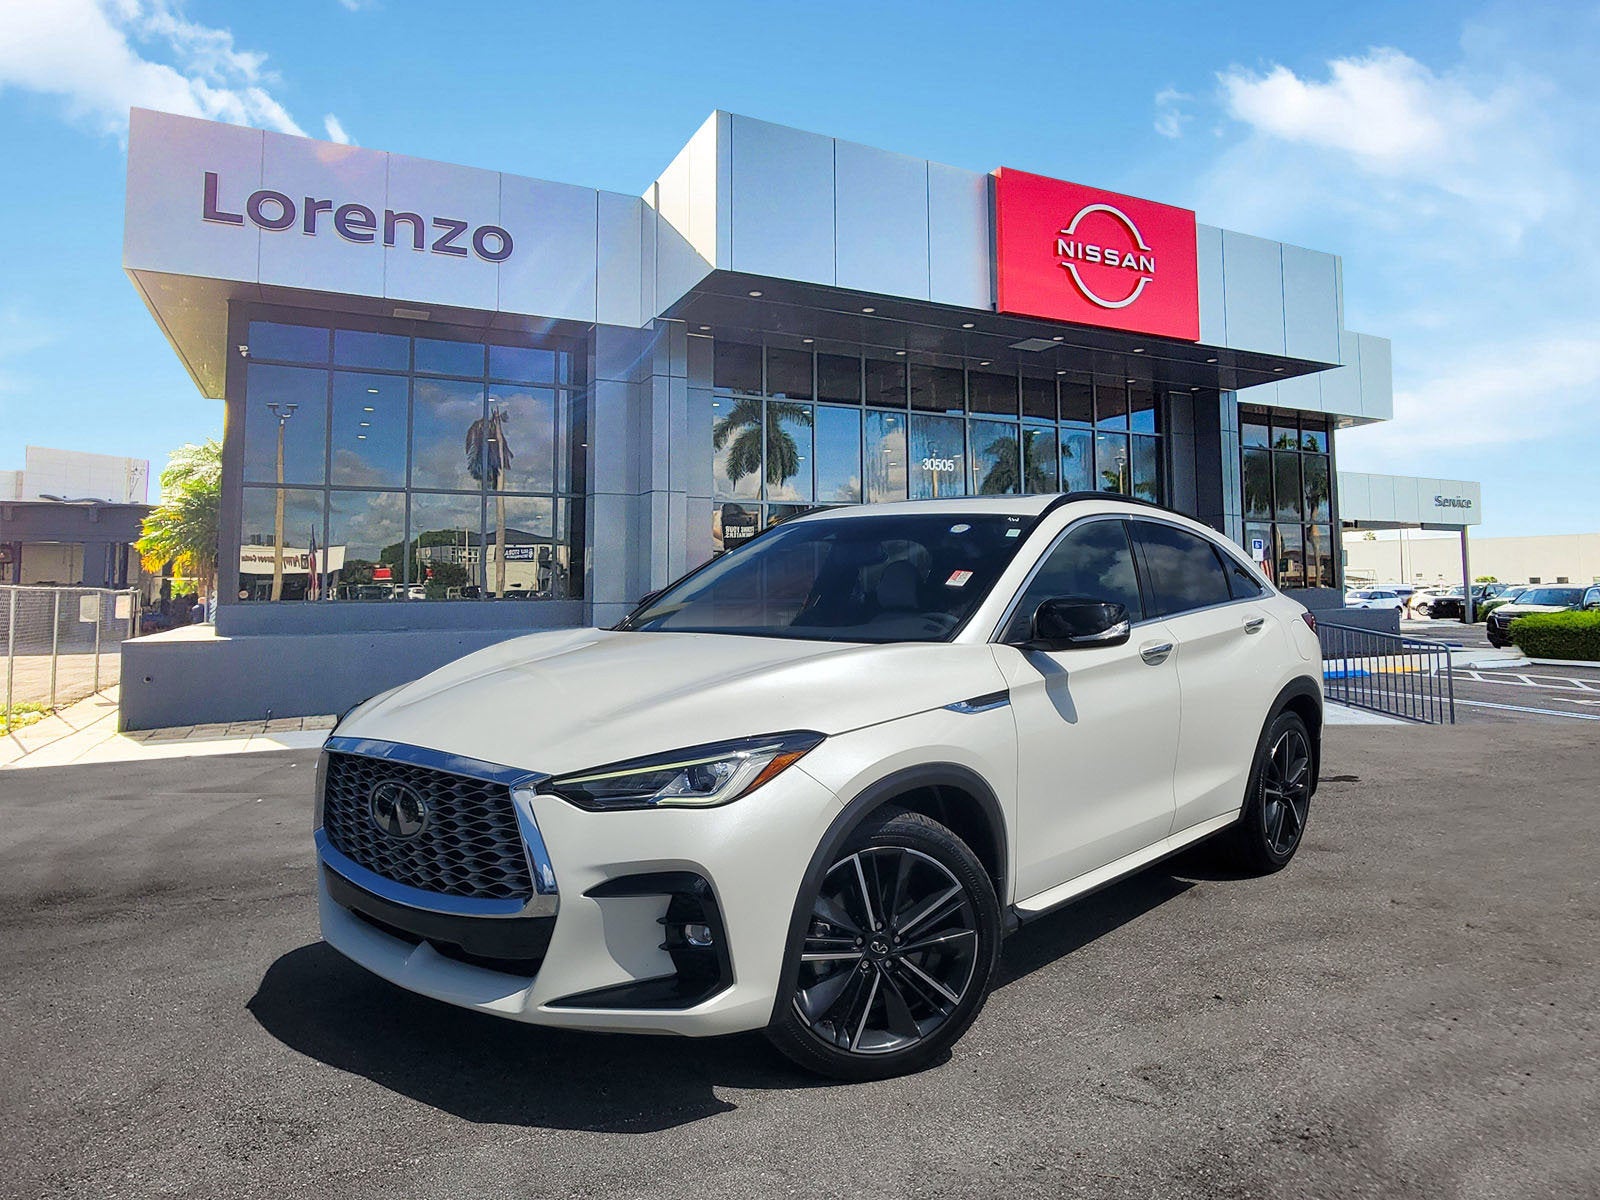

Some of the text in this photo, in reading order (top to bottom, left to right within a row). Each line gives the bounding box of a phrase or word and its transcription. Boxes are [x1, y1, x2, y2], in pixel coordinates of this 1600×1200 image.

[202, 171, 514, 262] Lorenzo
[1057, 238, 1155, 273] NISSAN
[922, 458, 954, 471] 30505
[1434, 495, 1472, 508] Service
